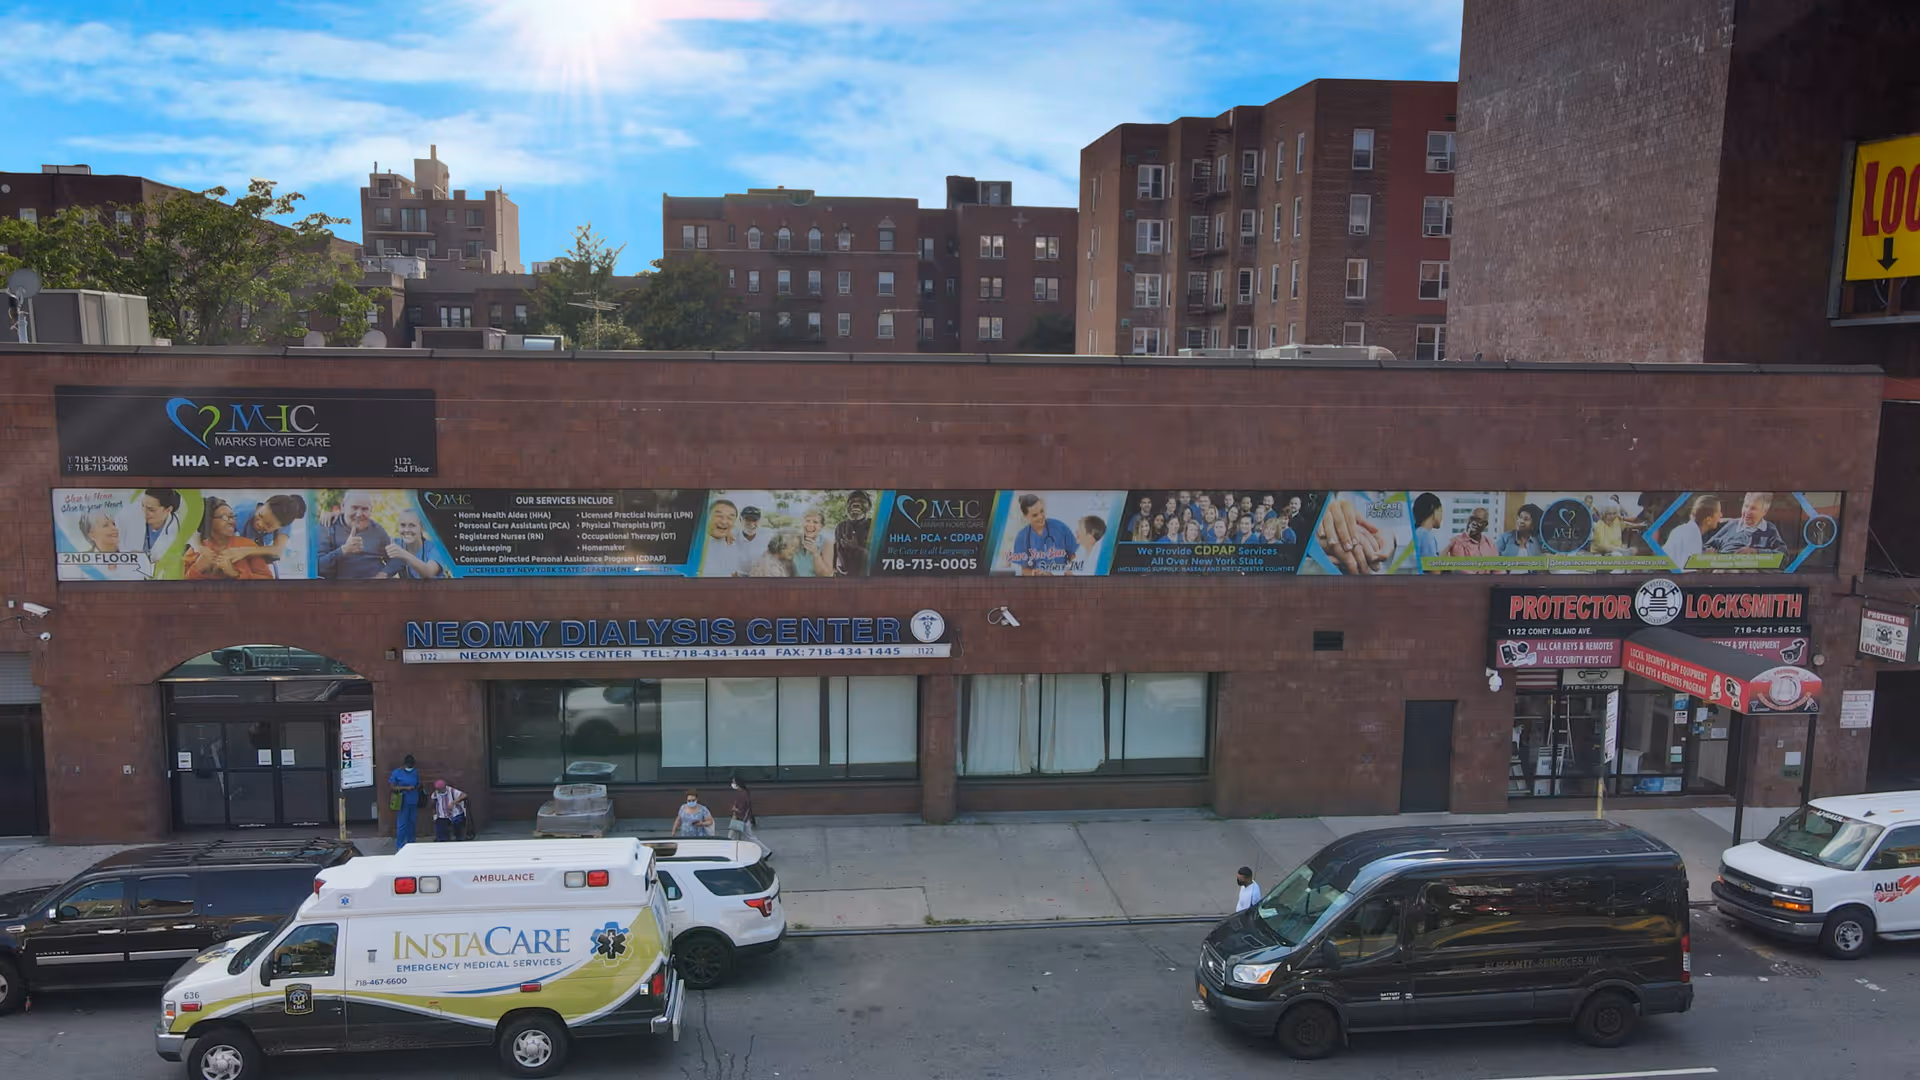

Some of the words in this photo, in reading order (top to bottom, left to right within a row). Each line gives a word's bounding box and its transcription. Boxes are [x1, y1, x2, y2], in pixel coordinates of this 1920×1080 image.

[214, 437, 257, 447] MARKS
[259, 437, 295, 447] HOME
[297, 437, 331, 447] CARE
[75, 456, 128, 464] 718-713-0005
[172, 455, 210, 467] HHA
[224, 455, 259, 467] PCA
[273, 456, 328, 467] CDPAP
[75, 464, 128, 472] 718-713-0008
[516, 496, 534, 505] OUR
[536, 496, 576, 505] SERVICES
[577, 496, 614, 505] INCLUDE
[482, 511, 506, 519] Health
[507, 511, 528, 519] Aides
[529, 511, 551, 519] (HHA)
[581, 511, 613, 519] Licensed
[614, 511, 646, 519] Practical
[673, 511, 693, 519] (LPN)
[549, 522, 570, 530] (PCA)
[581, 522, 611, 530] Physical
[612, 522, 649, 530] Therapists
[651, 522, 665, 530] (PT)
[459, 533, 499, 541] Registered
[527, 533, 544, 541] (RN)
[581, 533, 629, 541] Occupational
[630, 533, 659, 541] Therapy
[661, 532, 676, 540] (OT)
[889, 534, 911, 542] HHA
[920, 534, 941, 542] PCA
[950, 533, 984, 542] CDPAP
[459, 544, 512, 553] Housekeeping
[1137, 547, 1153, 555] We
[1155, 547, 1192, 555] Provide
[1194, 545, 1236, 555] CDPAP
[1238, 547, 1278, 555] Services
[63, 553, 91, 563] 2ND
[95, 553, 138, 563] FLOOR
[499, 555, 530, 563] Directed
[531, 555, 562, 563] Personal
[604, 555, 635, 563] Program
[636, 554, 666, 563] (CDPAP)
[1151, 557, 1165, 565] All
[1167, 557, 1188, 565] Over
[1191, 557, 1214, 565] New
[1215, 557, 1236, 565] York
[1238, 557, 1264, 565] State
[882, 558, 977, 570] 718-713-0005
[1509, 595, 1631, 620] PROTECTOR
[1685, 593, 1802, 619] LOCKSMITH
[1867, 611, 1905, 625] PROTECTOR
[406, 620, 550, 648] NEOMY
[561, 618, 737, 646] DIALYSIS
[746, 616, 901, 644] CENTER
[1507, 628, 1526, 636] 1122
[1578, 627, 1593, 635] AVE.
[1733, 626, 1802, 634] 718-421-5625
[1536, 642, 1547, 651] ALL
[1549, 642, 1560, 651] CAR
[1562, 642, 1577, 651] KEYS
[1585, 642, 1613, 651] REMOTES
[1738, 641, 1748, 650] SPY
[1749, 641, 1780, 650] EQUIPMENT
[420, 652, 438, 661] 1122
[459, 651, 510, 660] NEOMY
[515, 651, 575, 660] DIALYSIS
[579, 650, 632, 659] CENTER
[917, 647, 934, 655] 1122
[1861, 642, 1905, 660] LOCKSMITH
[1543, 656, 1554, 665] ALL
[1555, 656, 1582, 664] SECURITY
[1584, 656, 1599, 664] KEYS
[1600, 656, 1612, 664] CUT
[1645, 653, 1666, 667] SECURITY
[1671, 662, 1680, 672] SPY
[1680, 665, 1707, 682] EQUIPMENT
[1636, 662, 1645, 673] CAR
[1645, 665, 1657, 677] KEYS
[1661, 672, 1682, 687] REMOTES
[1682, 678, 1707, 696] PROGRAM
[472, 873, 535, 882] AMBULANCE
[396, 962, 460, 972] EMERGENCY
[463, 960, 509, 969] MEDICAL
[513, 958, 562, 967] SERVICES
[354, 977, 407, 986] 718-467-6600
[184, 991, 200, 1000] 636
